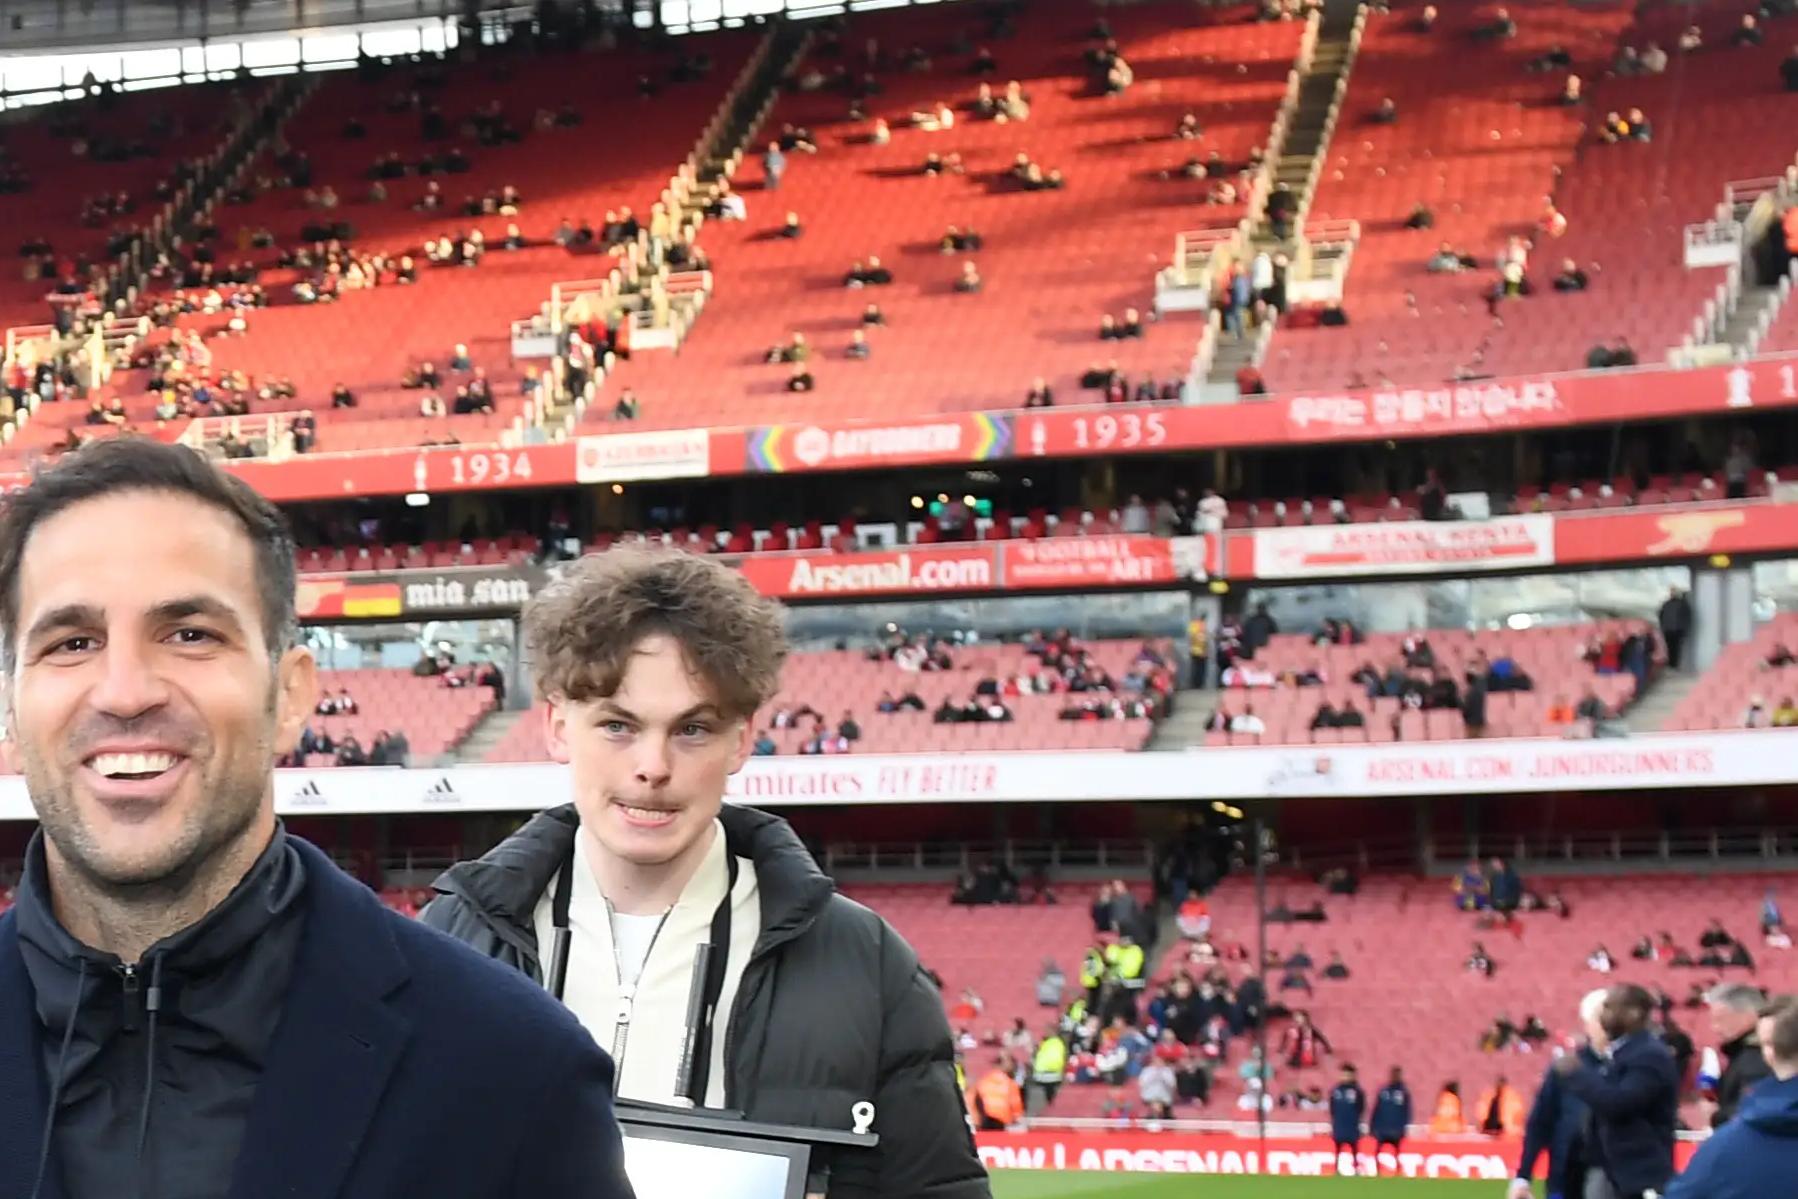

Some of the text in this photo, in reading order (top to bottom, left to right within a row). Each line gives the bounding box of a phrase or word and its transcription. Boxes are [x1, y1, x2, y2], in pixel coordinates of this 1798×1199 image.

[1072, 412, 1167, 449] 1935
[450, 452, 533, 484] 1934
[788, 554, 990, 592] Arsenal.com
[407, 577, 530, 606] mia san
[876, 764, 916, 795] FLY
[918, 763, 999, 794] BETTER
